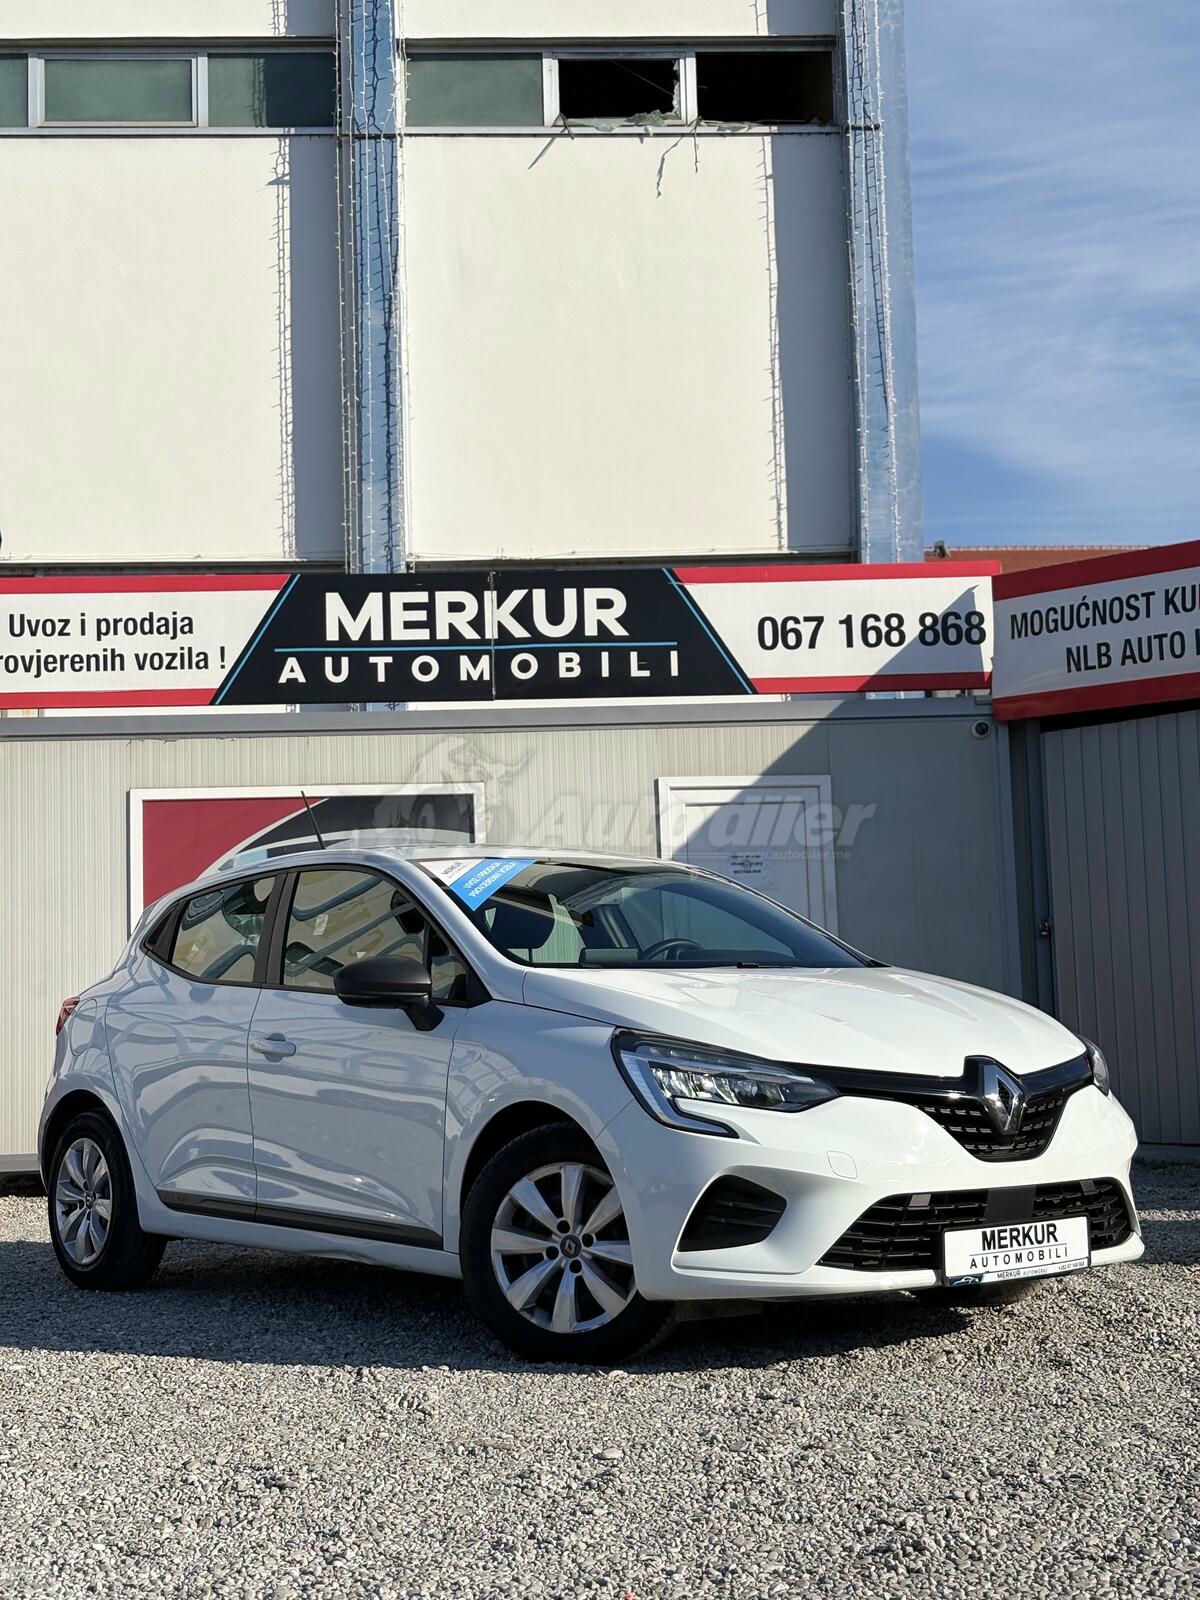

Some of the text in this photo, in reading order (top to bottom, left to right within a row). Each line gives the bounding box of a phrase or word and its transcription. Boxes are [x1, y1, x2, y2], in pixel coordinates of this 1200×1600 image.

[8, 612, 194, 641] Uvoz i prodaja
[325, 588, 630, 641] MERKUR
[1010, 584, 1200, 640] MOGUĆNOST KU
[757, 610, 986, 650] 067 168 868
[134, 647, 209, 671] vozila
[219, 646, 226, 669] !
[278, 650, 679, 684] AUTOMOBILI
[1065, 641, 1112, 673] NLB
[1120, 630, 1186, 666] AUTO
[981, 1223, 1058, 1250] MERKUR
[970, 1246, 1068, 1269] AUTOMOBILI
[997, 1270, 1021, 1279] MERKUR
